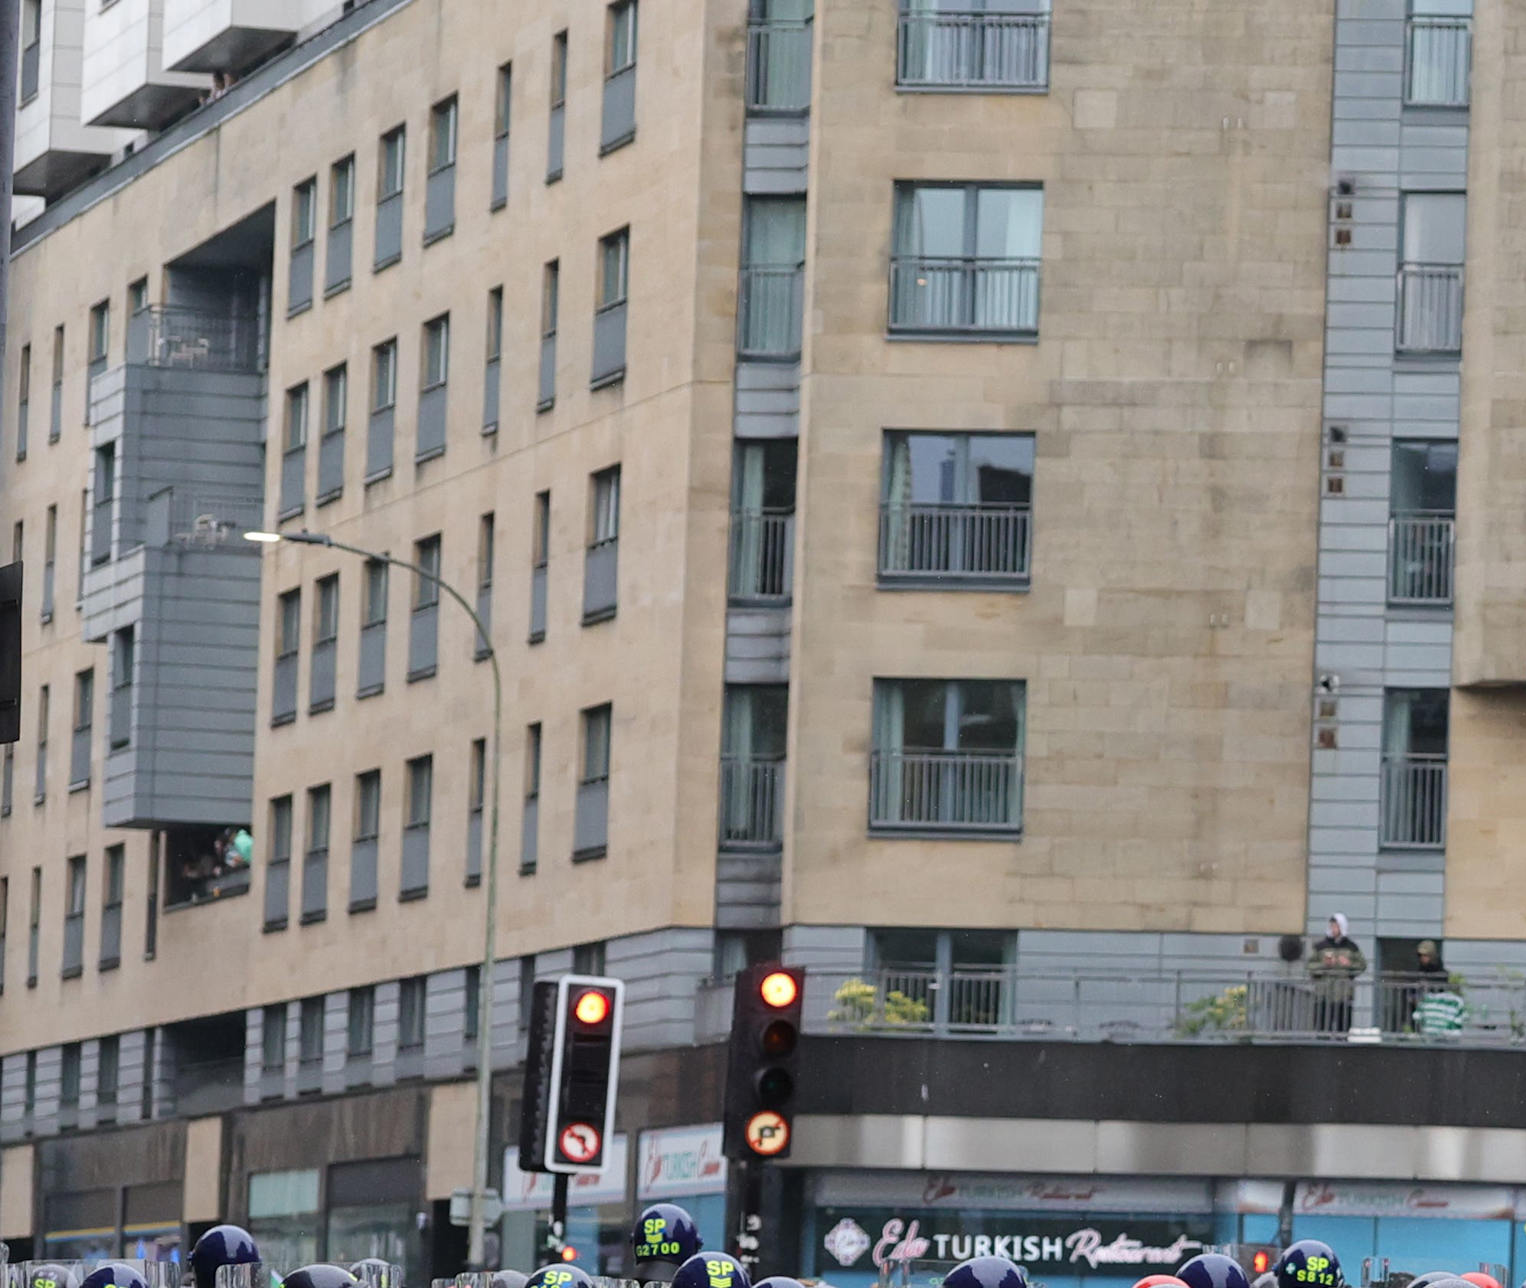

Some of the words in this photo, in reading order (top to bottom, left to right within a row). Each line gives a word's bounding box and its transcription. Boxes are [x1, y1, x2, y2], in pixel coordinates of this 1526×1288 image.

[644, 1219, 666, 1234] SP
[636, 1241, 680, 1255] G2700
[934, 1232, 1062, 1261] TURKISH
[706, 1260, 734, 1276] SP
[1307, 1256, 1329, 1271] SP
[543, 1271, 573, 1285] SP
[1297, 1269, 1334, 1285] S812
